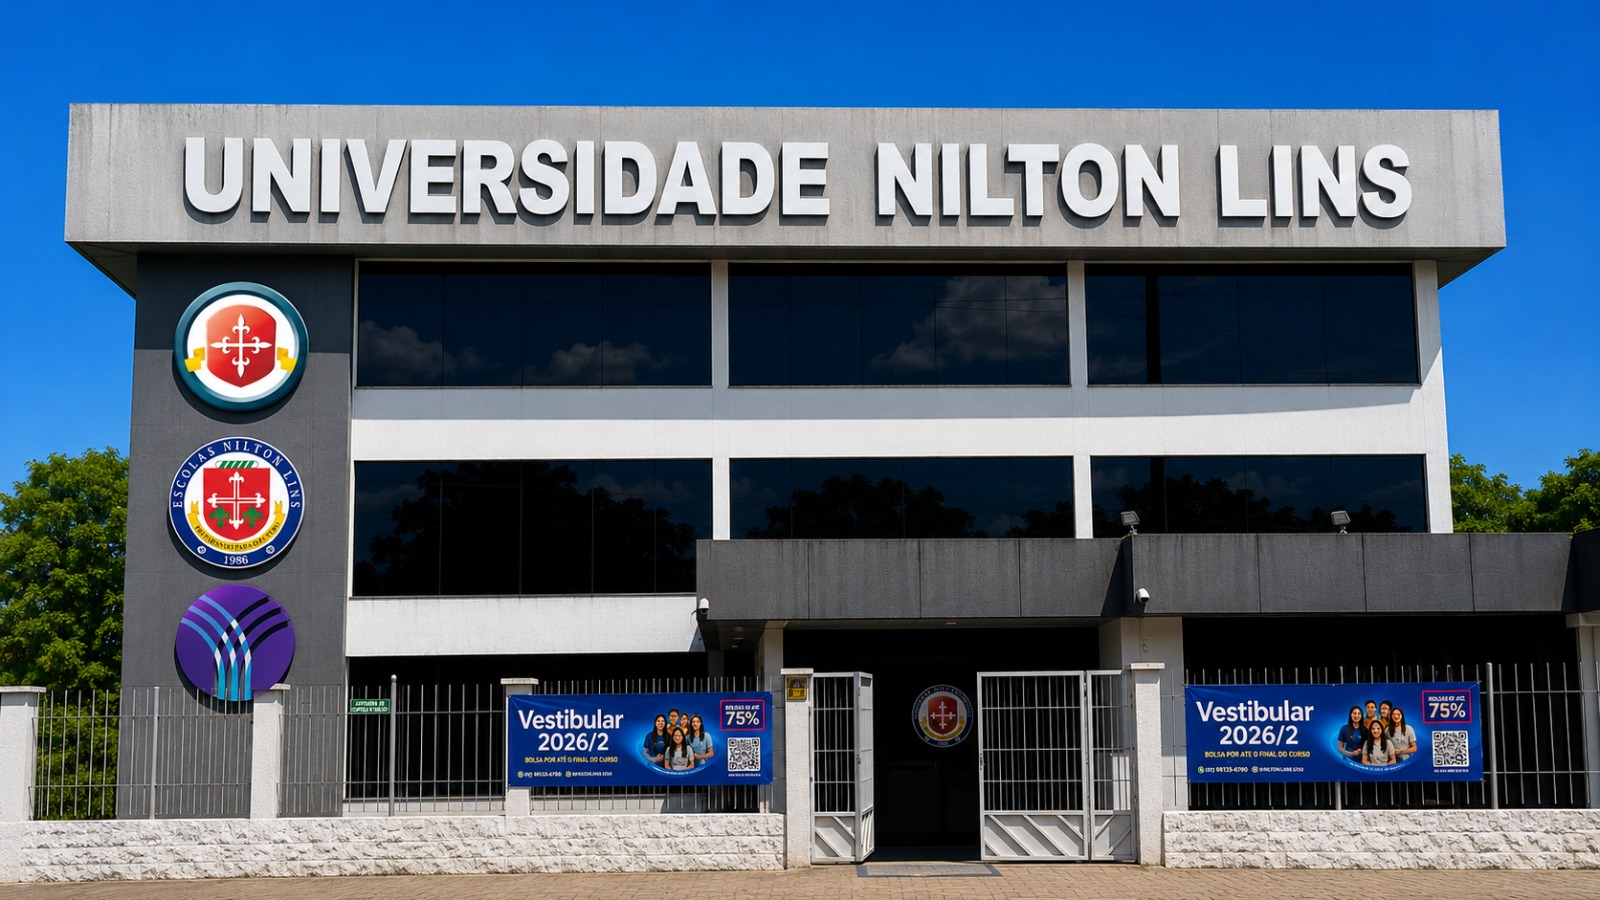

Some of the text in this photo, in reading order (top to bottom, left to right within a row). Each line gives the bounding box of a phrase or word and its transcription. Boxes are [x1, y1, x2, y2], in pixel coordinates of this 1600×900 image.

[184, 136, 1413, 219] UNIVERSIDADE NILTON LINS
[173, 440, 301, 509] ESCOLAS NILTON LINS
[223, 555, 249, 565] 1986
[518, 708, 624, 730] Vestibular
[725, 711, 760, 726] 75%
[1196, 699, 1315, 722] Vestibular
[1428, 702, 1466, 718] 75%
[537, 732, 609, 753] 2026/2
[1219, 725, 1299, 747] 2026/2
